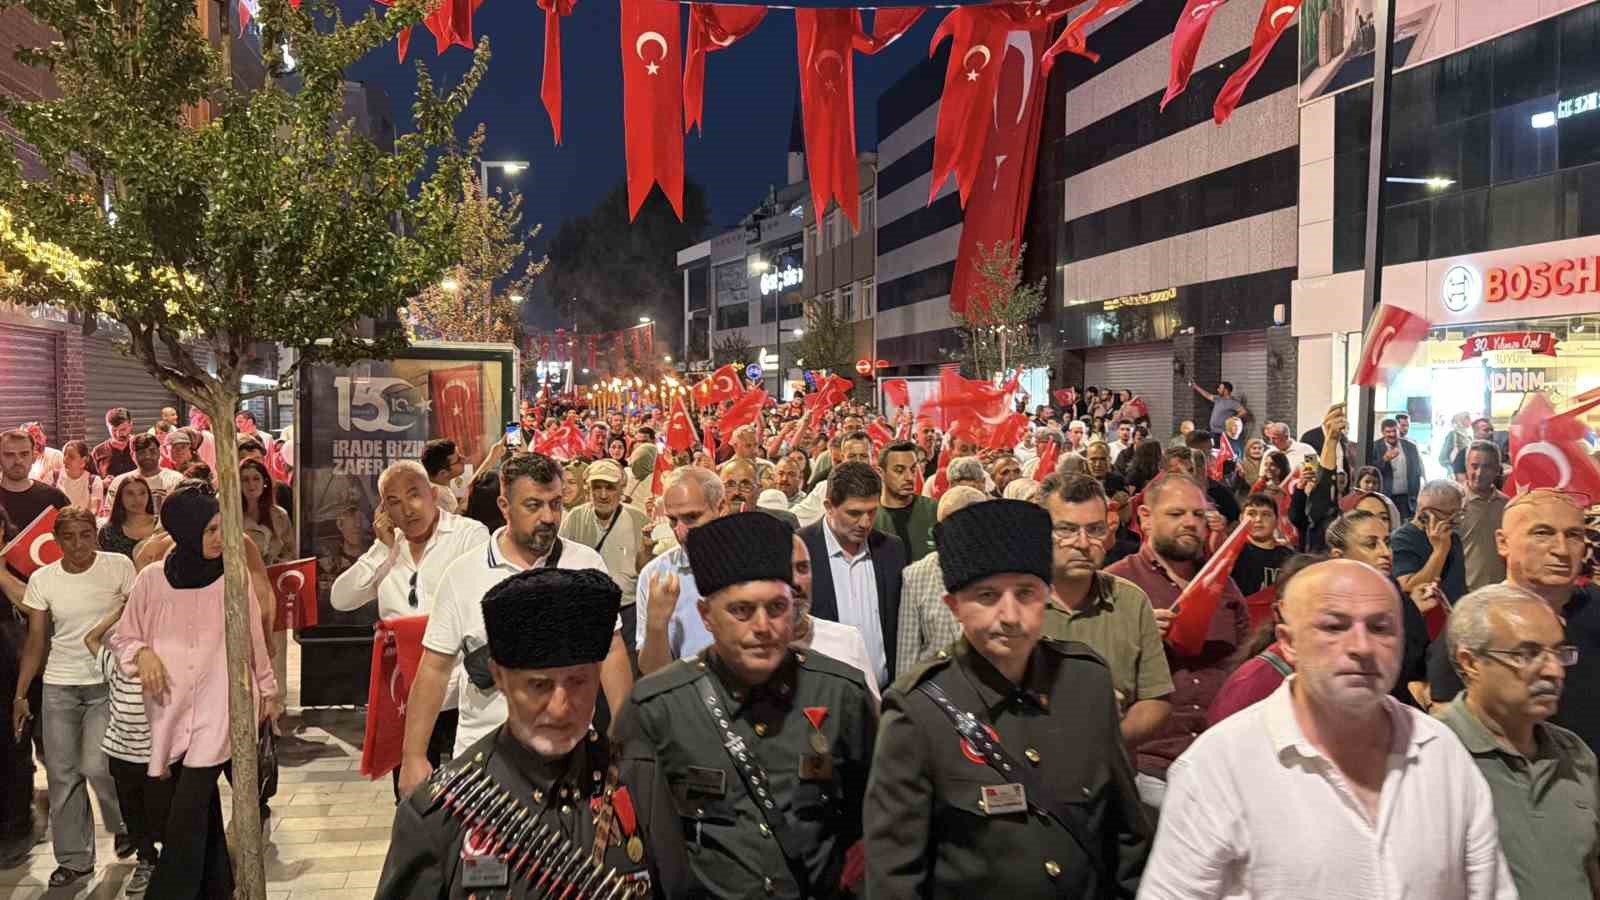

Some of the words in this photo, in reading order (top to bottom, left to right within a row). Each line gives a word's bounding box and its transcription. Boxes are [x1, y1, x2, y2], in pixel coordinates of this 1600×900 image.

[1486, 256, 1600, 302] BOSCH
[333, 438, 382, 457] İRADE
[333, 459, 384, 475] ZAFER
